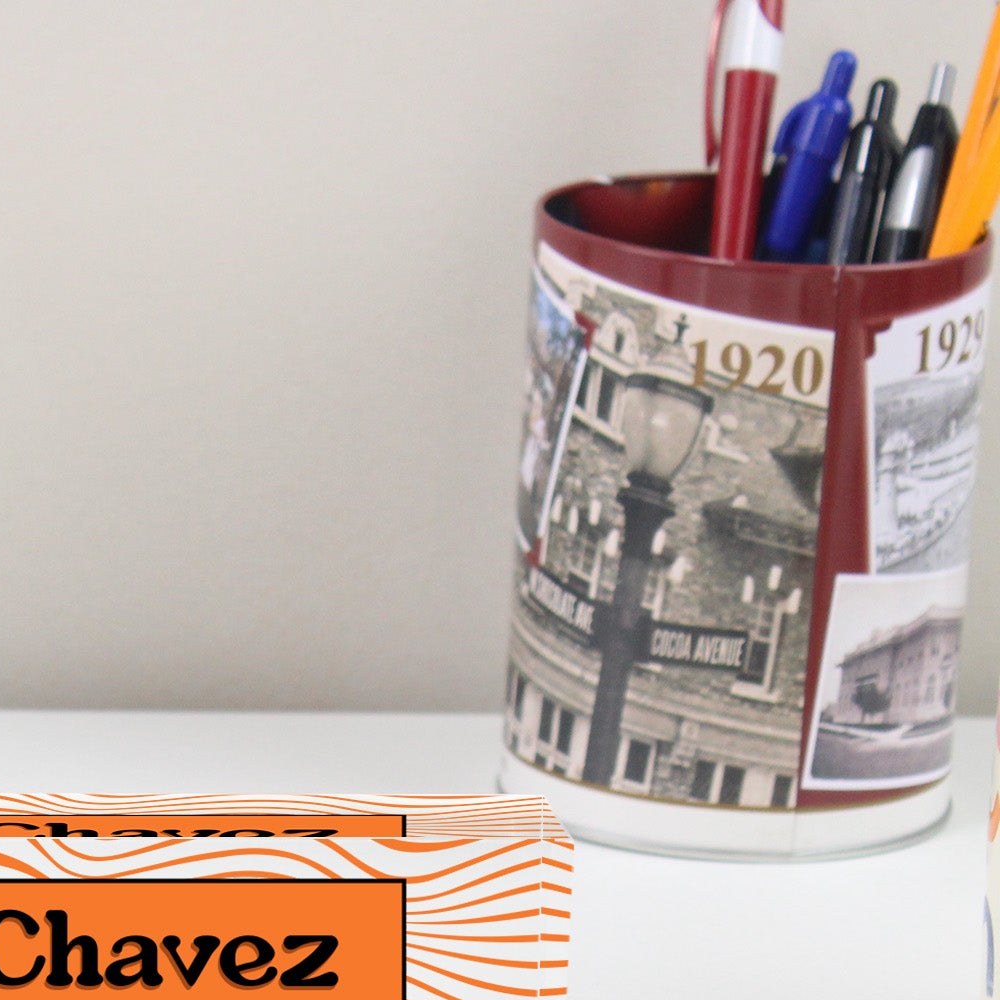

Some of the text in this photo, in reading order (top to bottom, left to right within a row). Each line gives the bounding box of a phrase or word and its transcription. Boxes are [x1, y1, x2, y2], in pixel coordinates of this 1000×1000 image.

[689, 339, 825, 396] 1920
[651, 629, 746, 667] COCOA AVENUE
